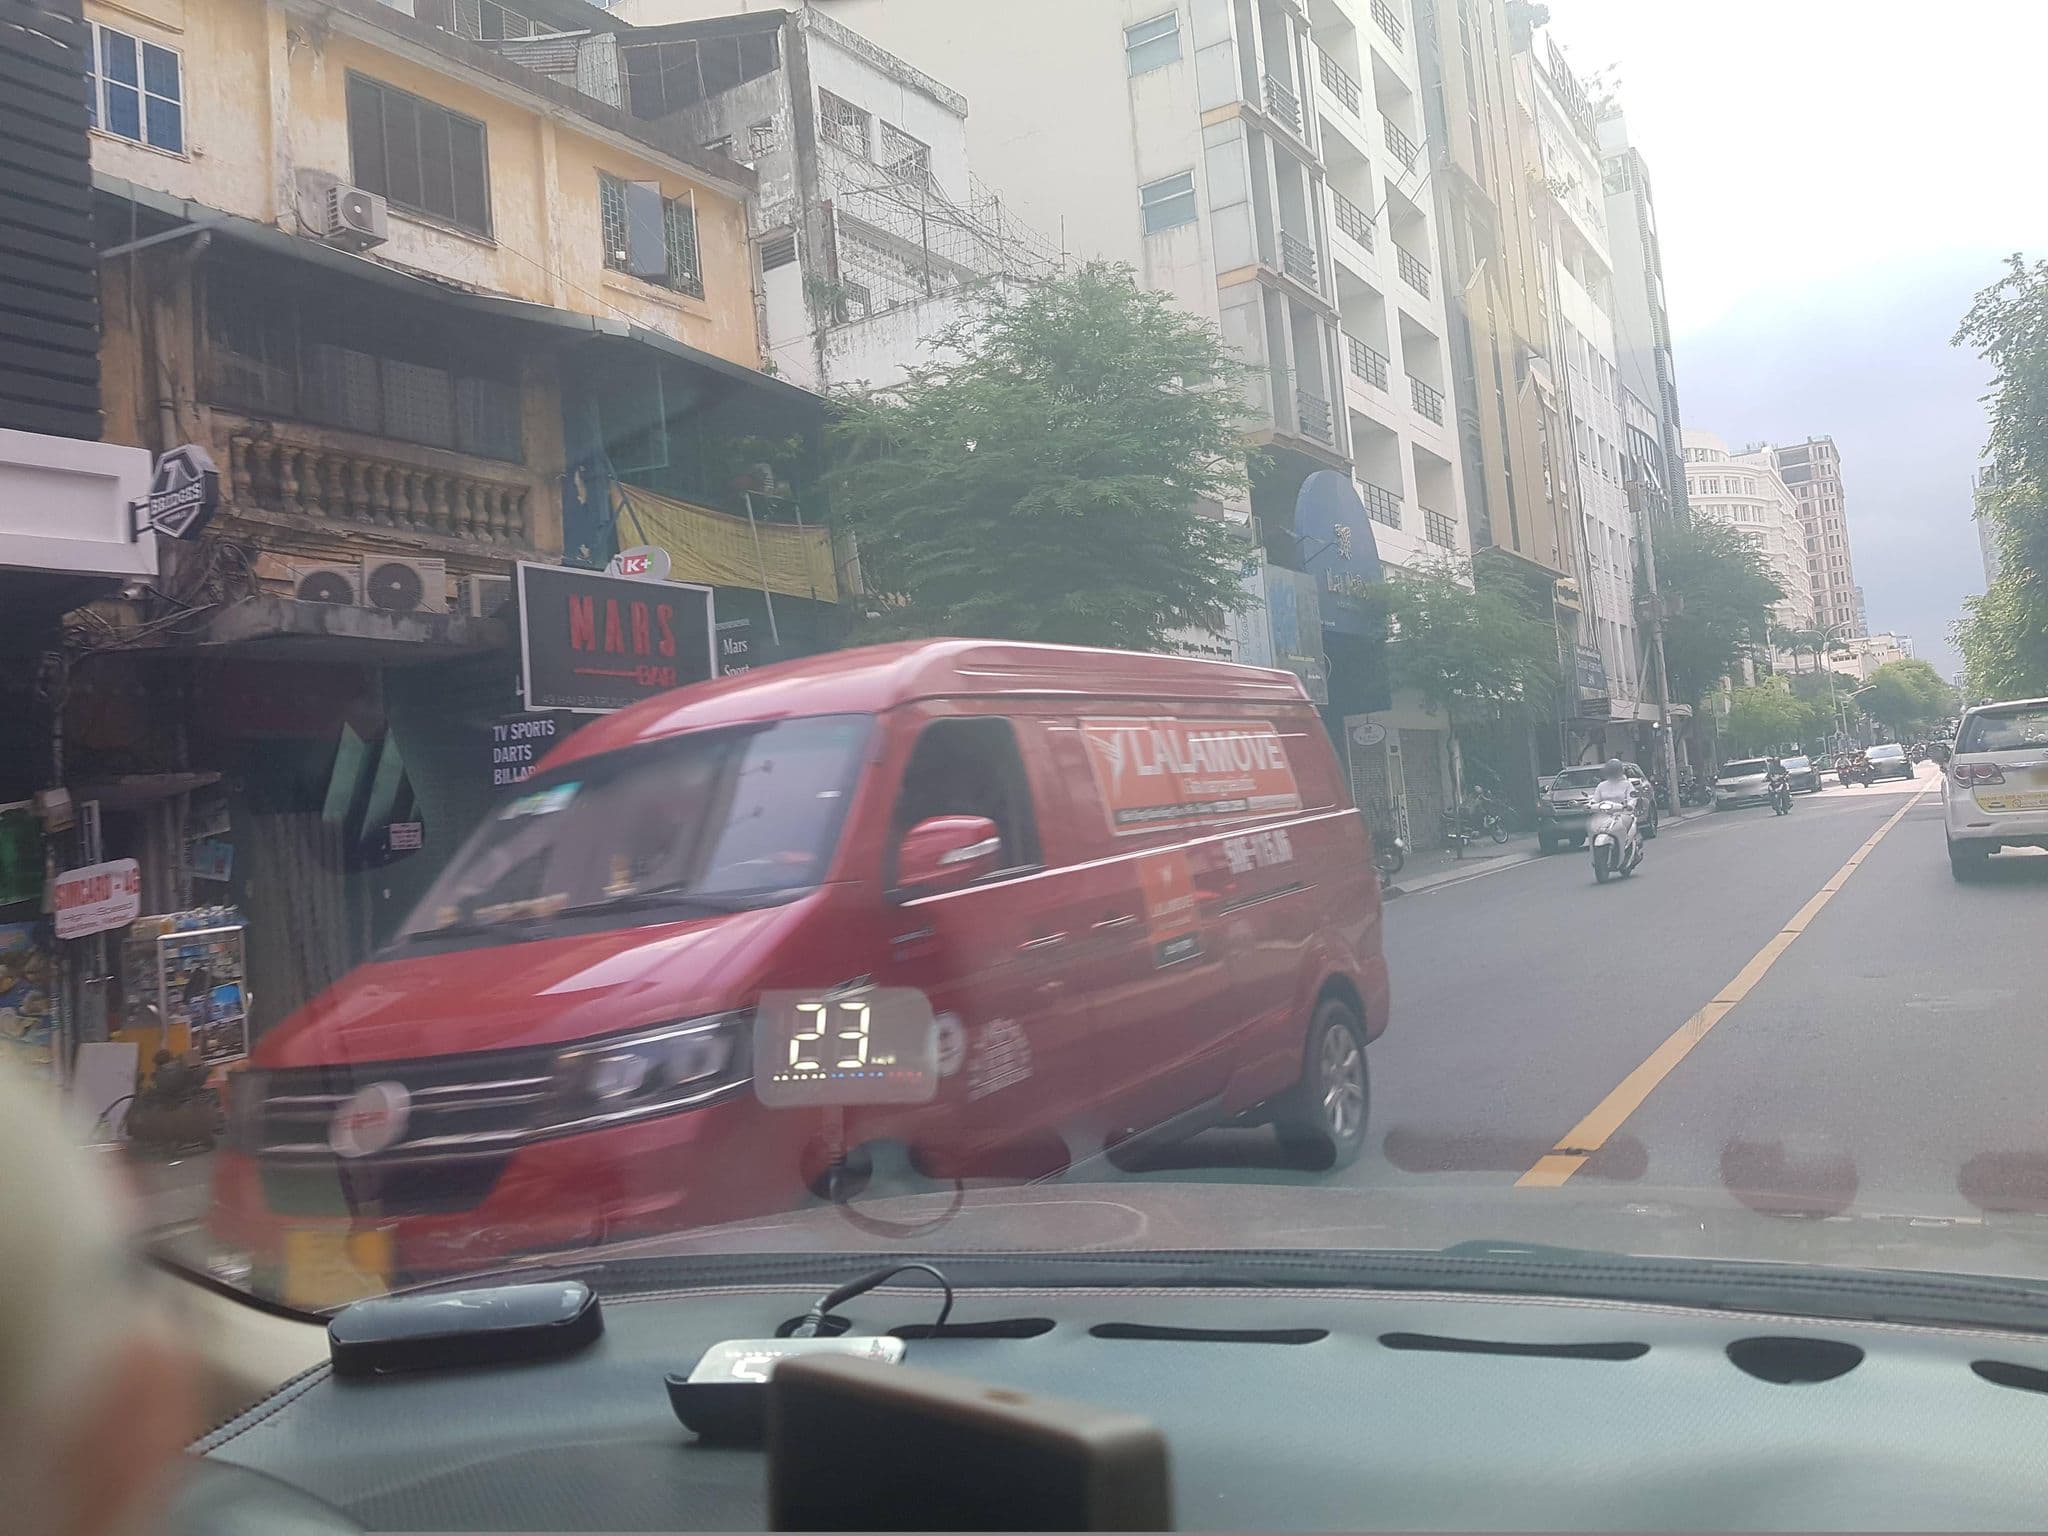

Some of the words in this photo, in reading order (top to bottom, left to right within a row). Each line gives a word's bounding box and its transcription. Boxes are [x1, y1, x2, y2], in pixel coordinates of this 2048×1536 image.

[569, 593, 676, 656] MARS
[723, 638, 748, 655] Mars
[492, 724, 509, 741] TV
[510, 719, 555, 740] SPORTS
[493, 744, 532, 763] DARTS
[1128, 729, 1286, 776] LALAMOVE
[493, 765, 540, 785] BILLAR
[789, 1002, 870, 1070] 23
